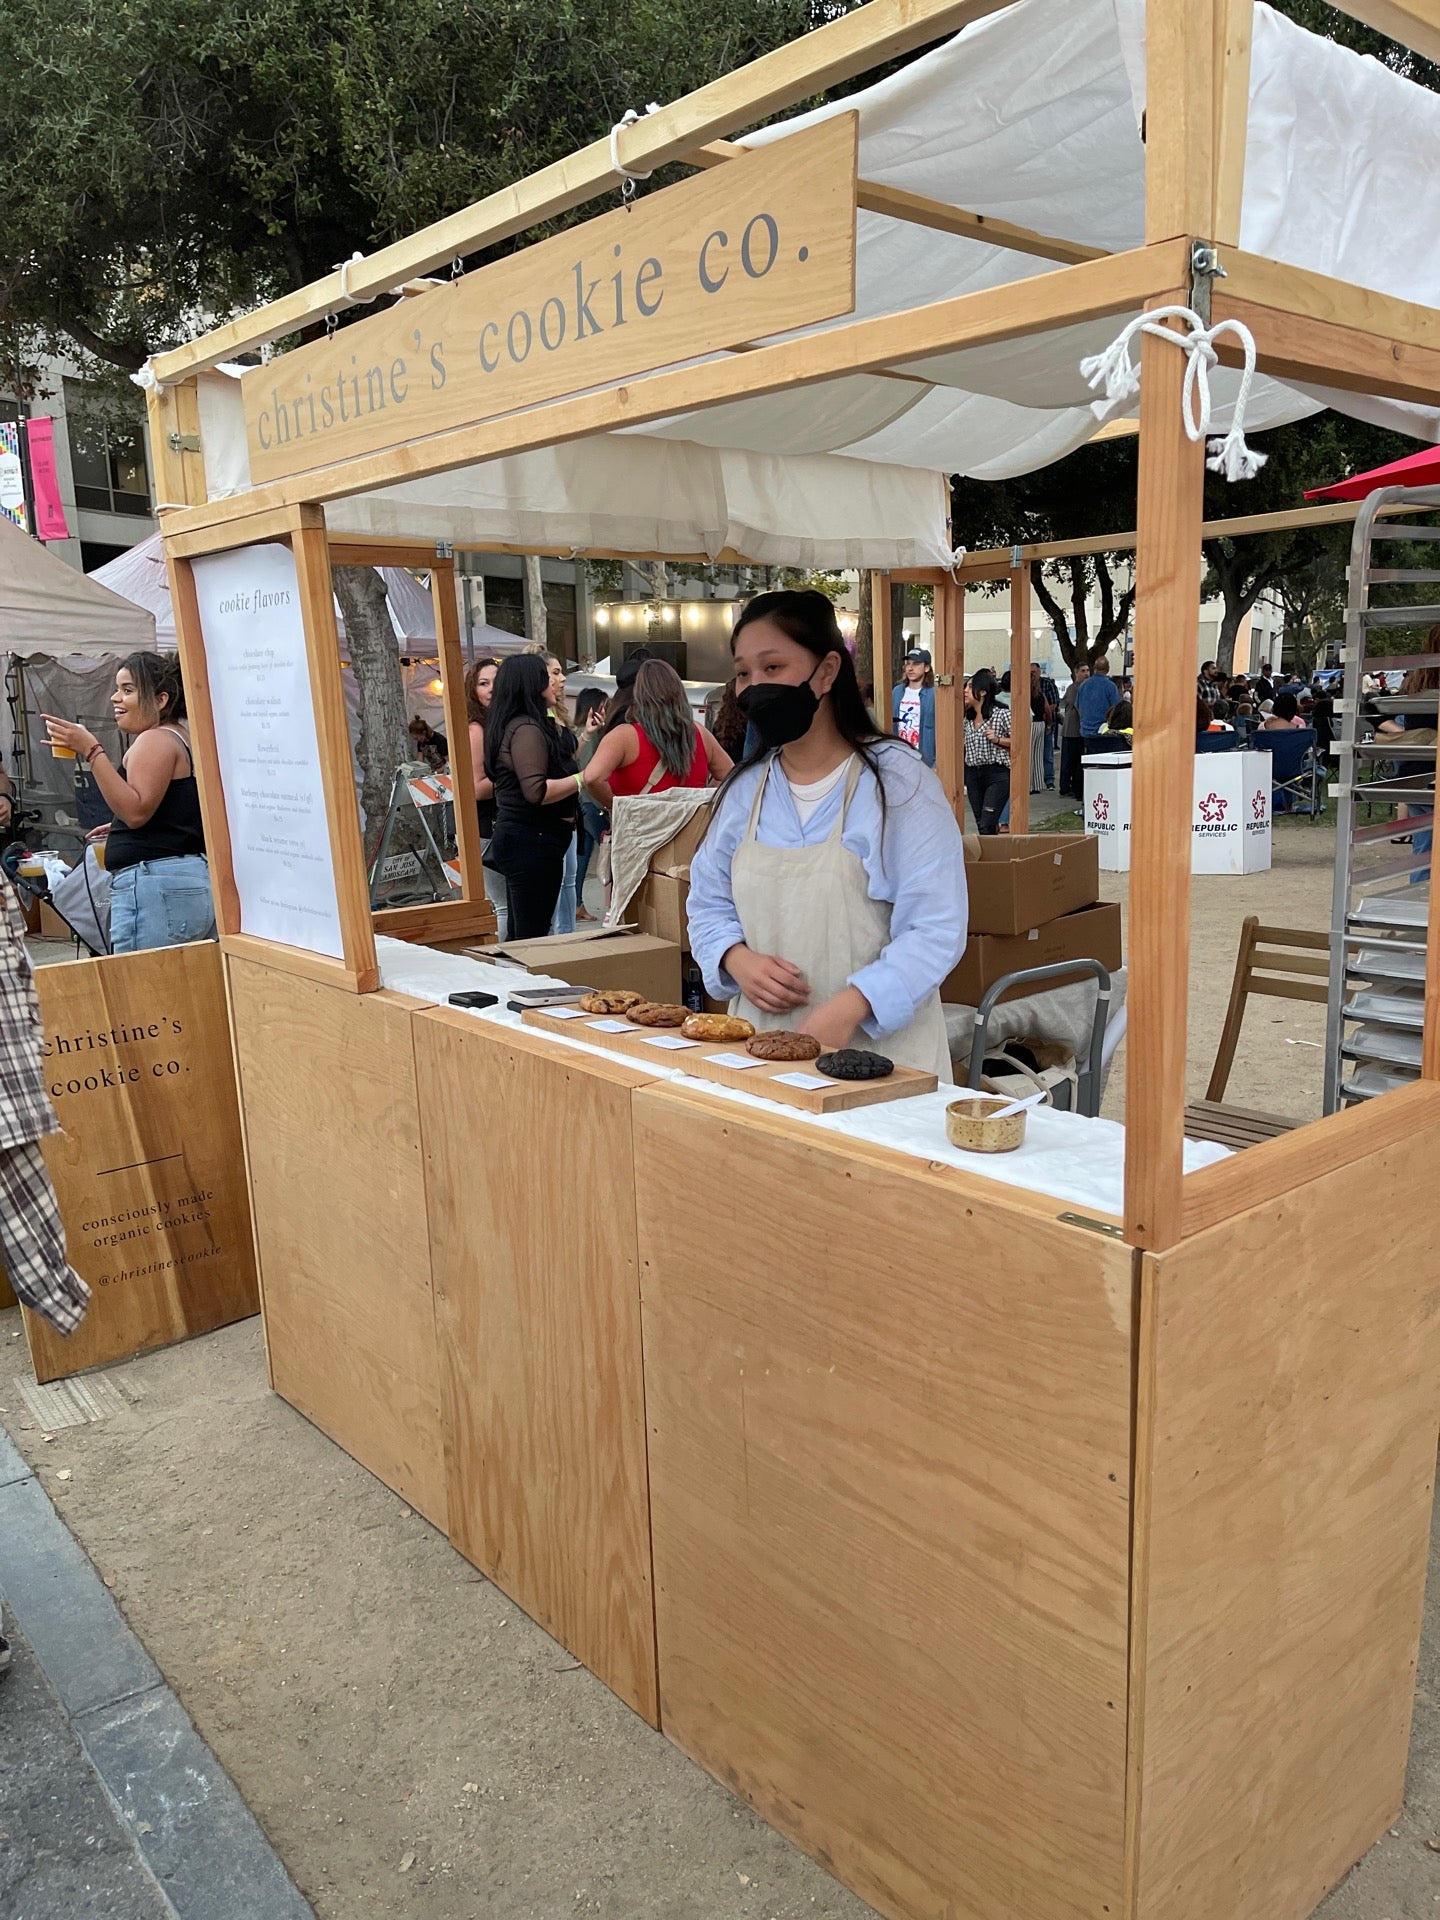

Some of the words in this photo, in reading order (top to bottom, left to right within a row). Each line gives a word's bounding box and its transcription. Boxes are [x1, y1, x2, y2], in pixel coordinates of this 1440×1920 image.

[258, 328, 446, 450] christine's
[479, 244, 664, 373] cookie
[698, 213, 809, 294] co.
[219, 592, 250, 614] cookie
[253, 589, 290, 614] flavors
[1087, 821, 1115, 831] REPUBLIC
[1246, 820, 1270, 831] REPUBLIC
[383, 863, 398, 873] SAN
[43, 1017, 182, 1057] christine's
[51, 1065, 141, 1097] cookie
[152, 1060, 190, 1077] co.
[82, 1202, 171, 1232] consciously
[177, 1190, 214, 1208] made
[93, 1224, 151, 1248] organic
[156, 1209, 211, 1231] cookies
[98, 1245, 222, 1287] @christinescookie
